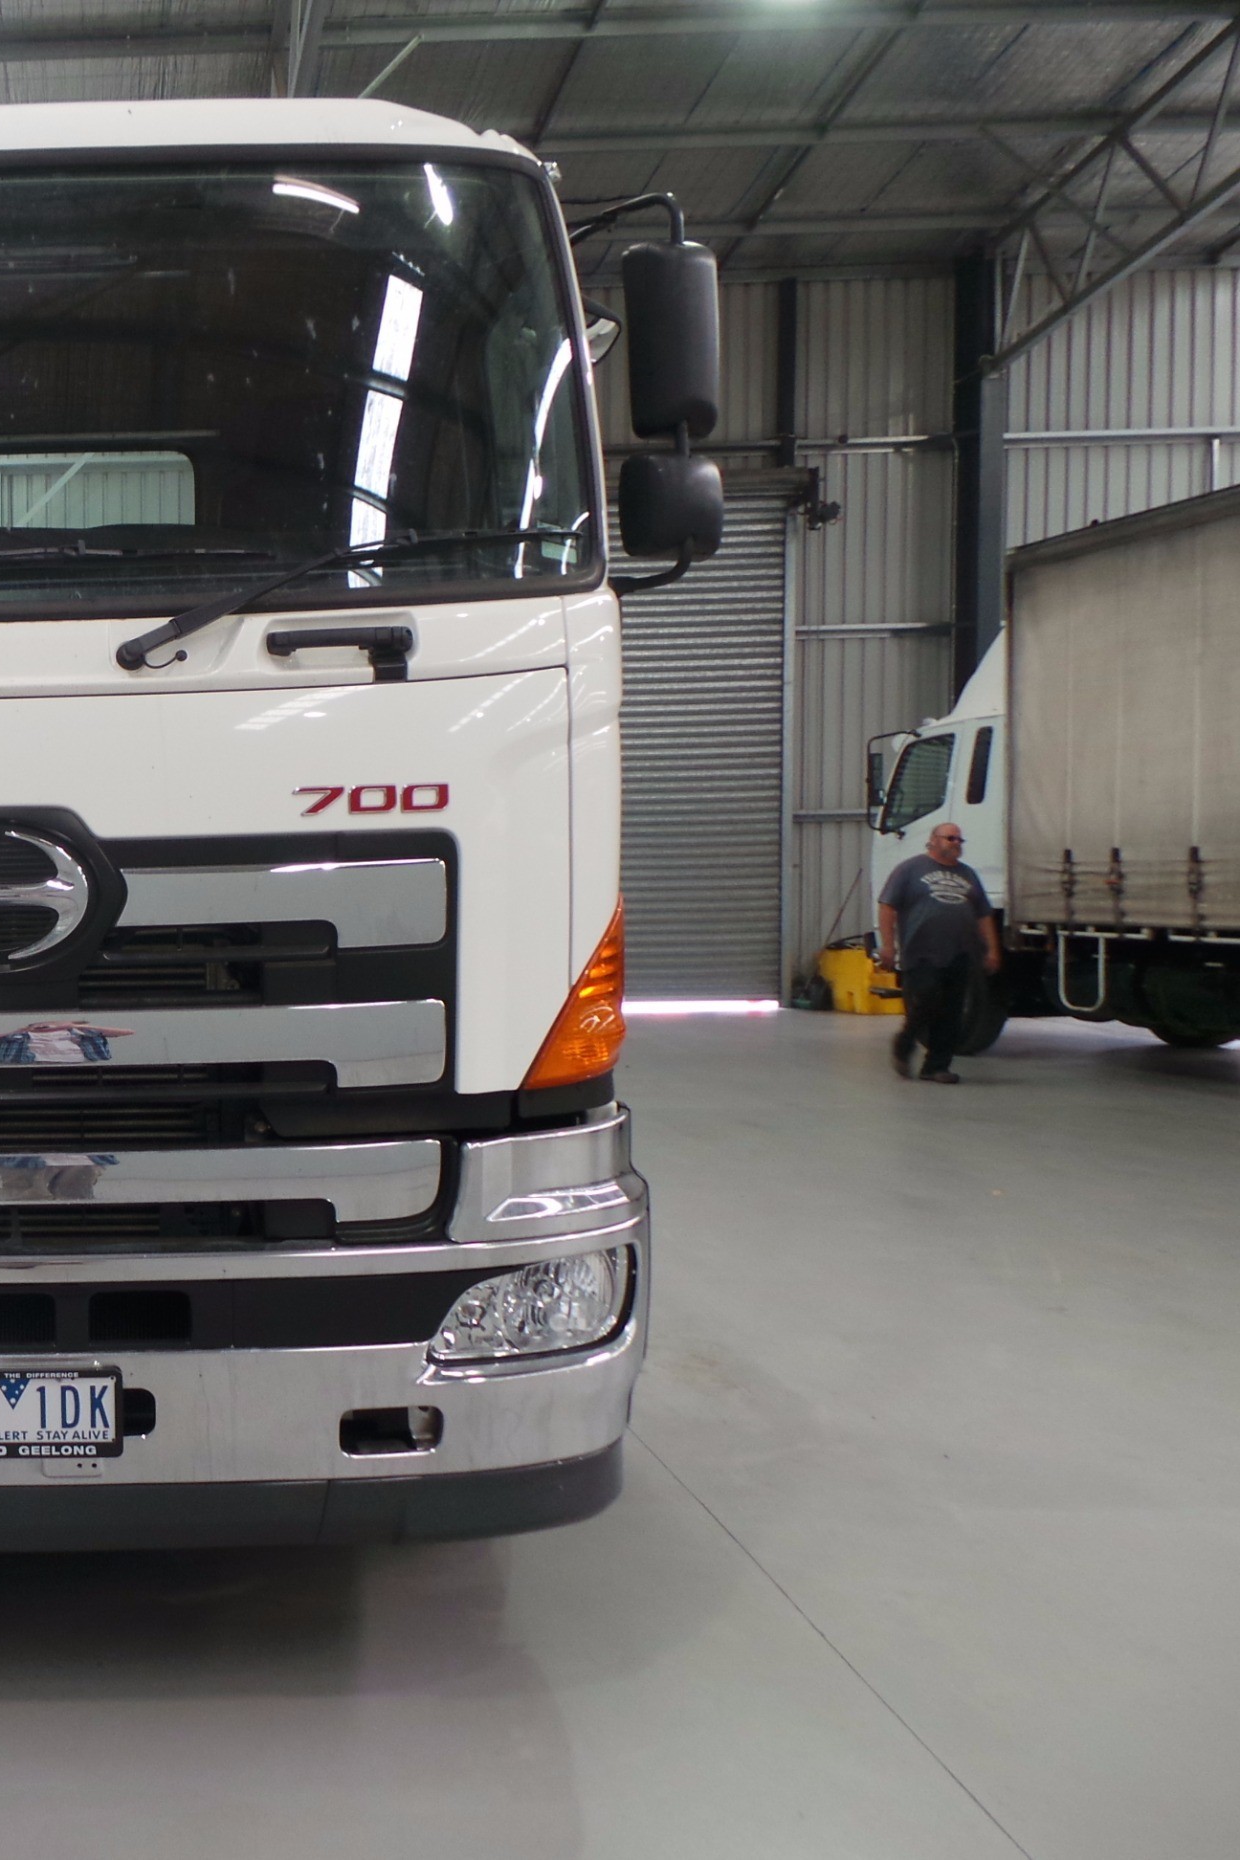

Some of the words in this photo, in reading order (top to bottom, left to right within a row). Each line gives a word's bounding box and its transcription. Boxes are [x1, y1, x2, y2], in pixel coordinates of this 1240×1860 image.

[292, 783, 449, 817] 700
[36, 1385, 110, 1429] 1DK
[36, 1430, 68, 1440] STAY
[72, 1430, 109, 1440] ALIVE
[18, 1445, 97, 1456] GEELONG
